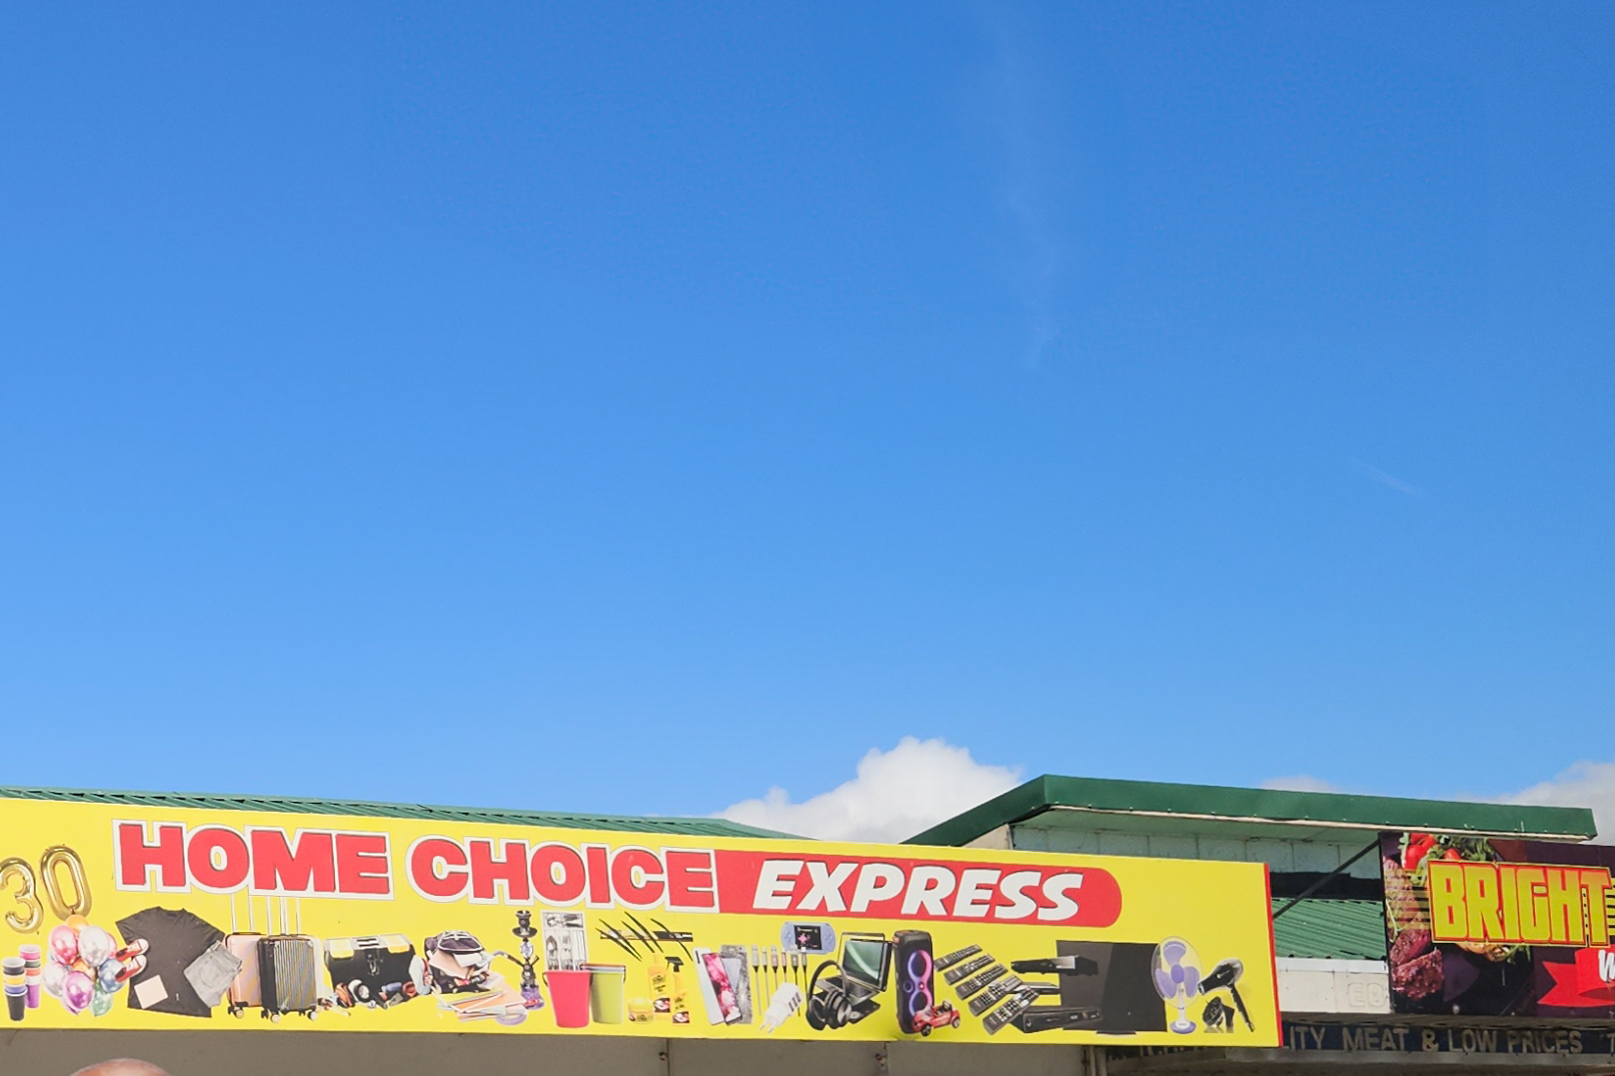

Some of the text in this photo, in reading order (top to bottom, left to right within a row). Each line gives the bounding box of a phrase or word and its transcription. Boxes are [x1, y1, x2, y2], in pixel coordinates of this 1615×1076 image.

[118, 821, 1085, 920] HOME CHOICE EXPRESS
[1429, 862, 1611, 946] BRIGHT
[1342, 1027, 1409, 1051] MEAT
[1422, 1029, 1439, 1051] &
[1448, 1029, 1497, 1053] LOW
[1507, 1030, 1583, 1054] PRICES
